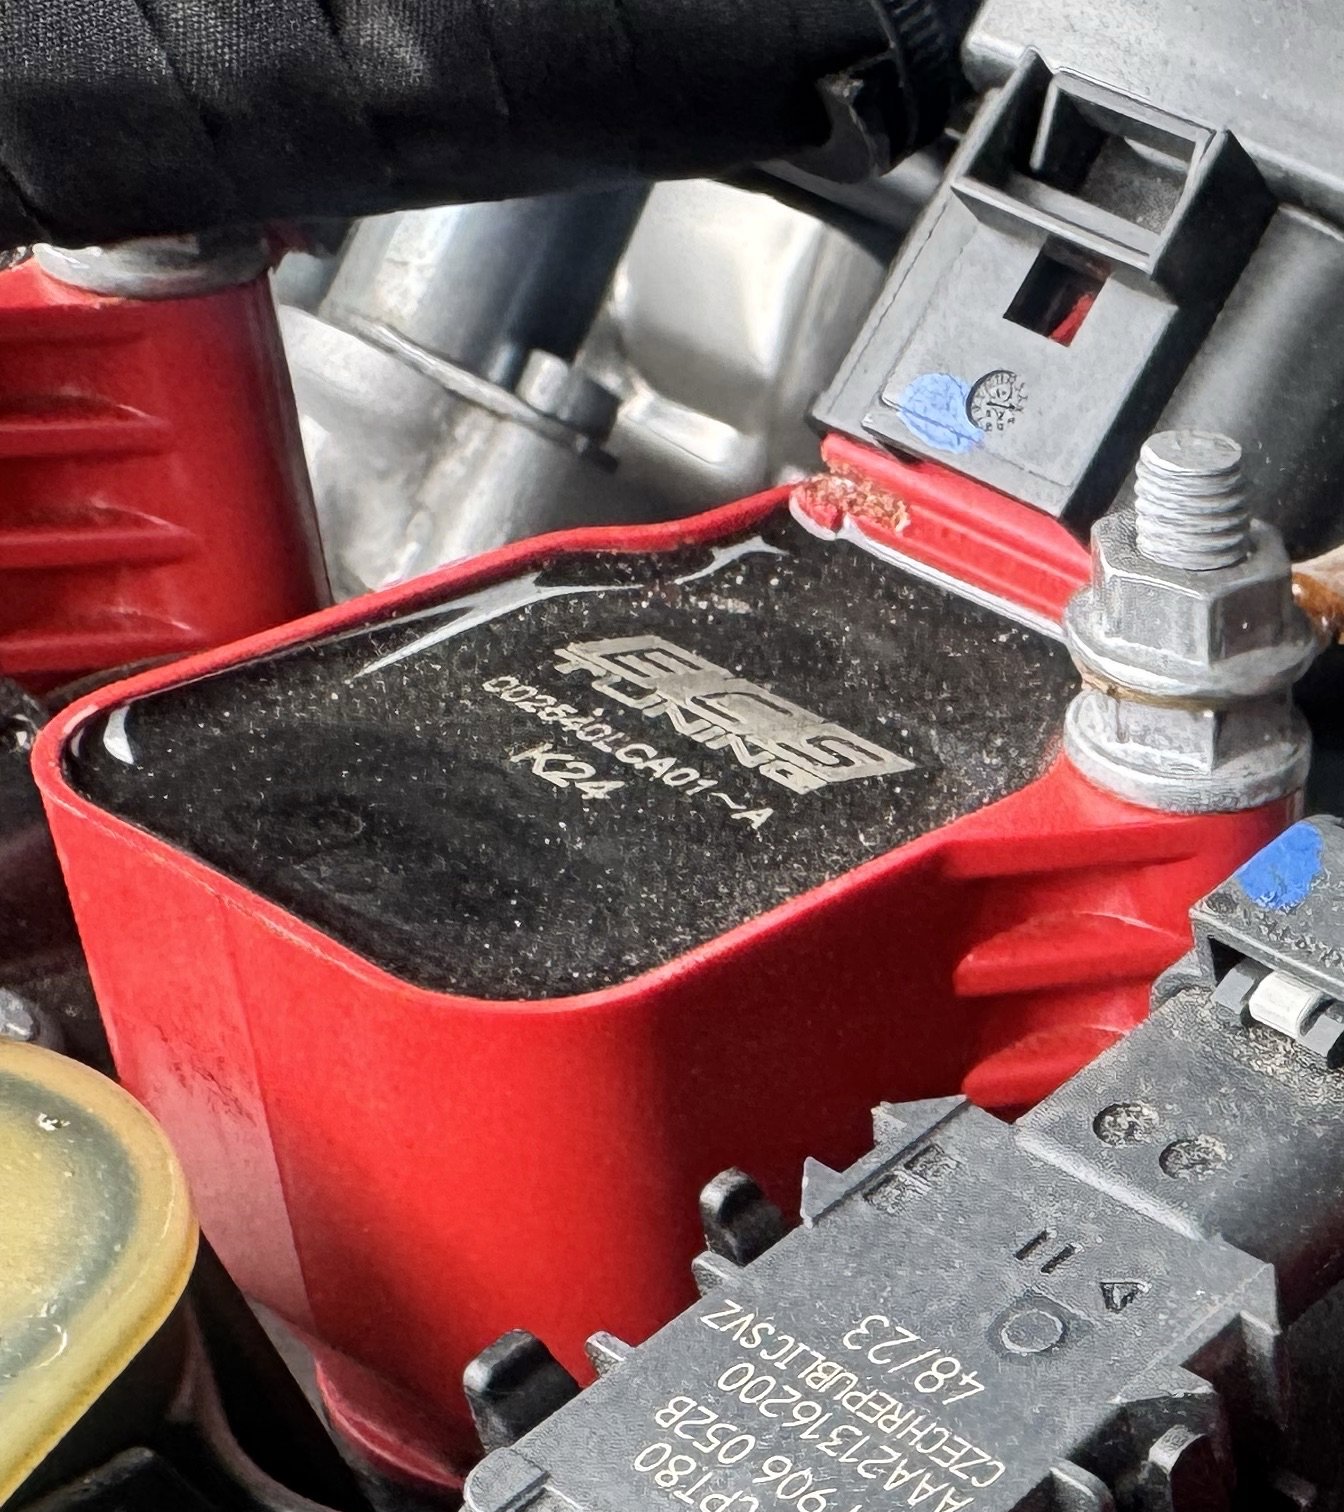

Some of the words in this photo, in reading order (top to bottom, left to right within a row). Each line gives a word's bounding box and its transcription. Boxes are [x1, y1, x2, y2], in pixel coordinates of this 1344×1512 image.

[567, 634, 917, 783] ECS
[510, 741, 626, 800] K24
[842, 1314, 985, 1406] 48/23
[654, 1395, 756, 1465] 052B
